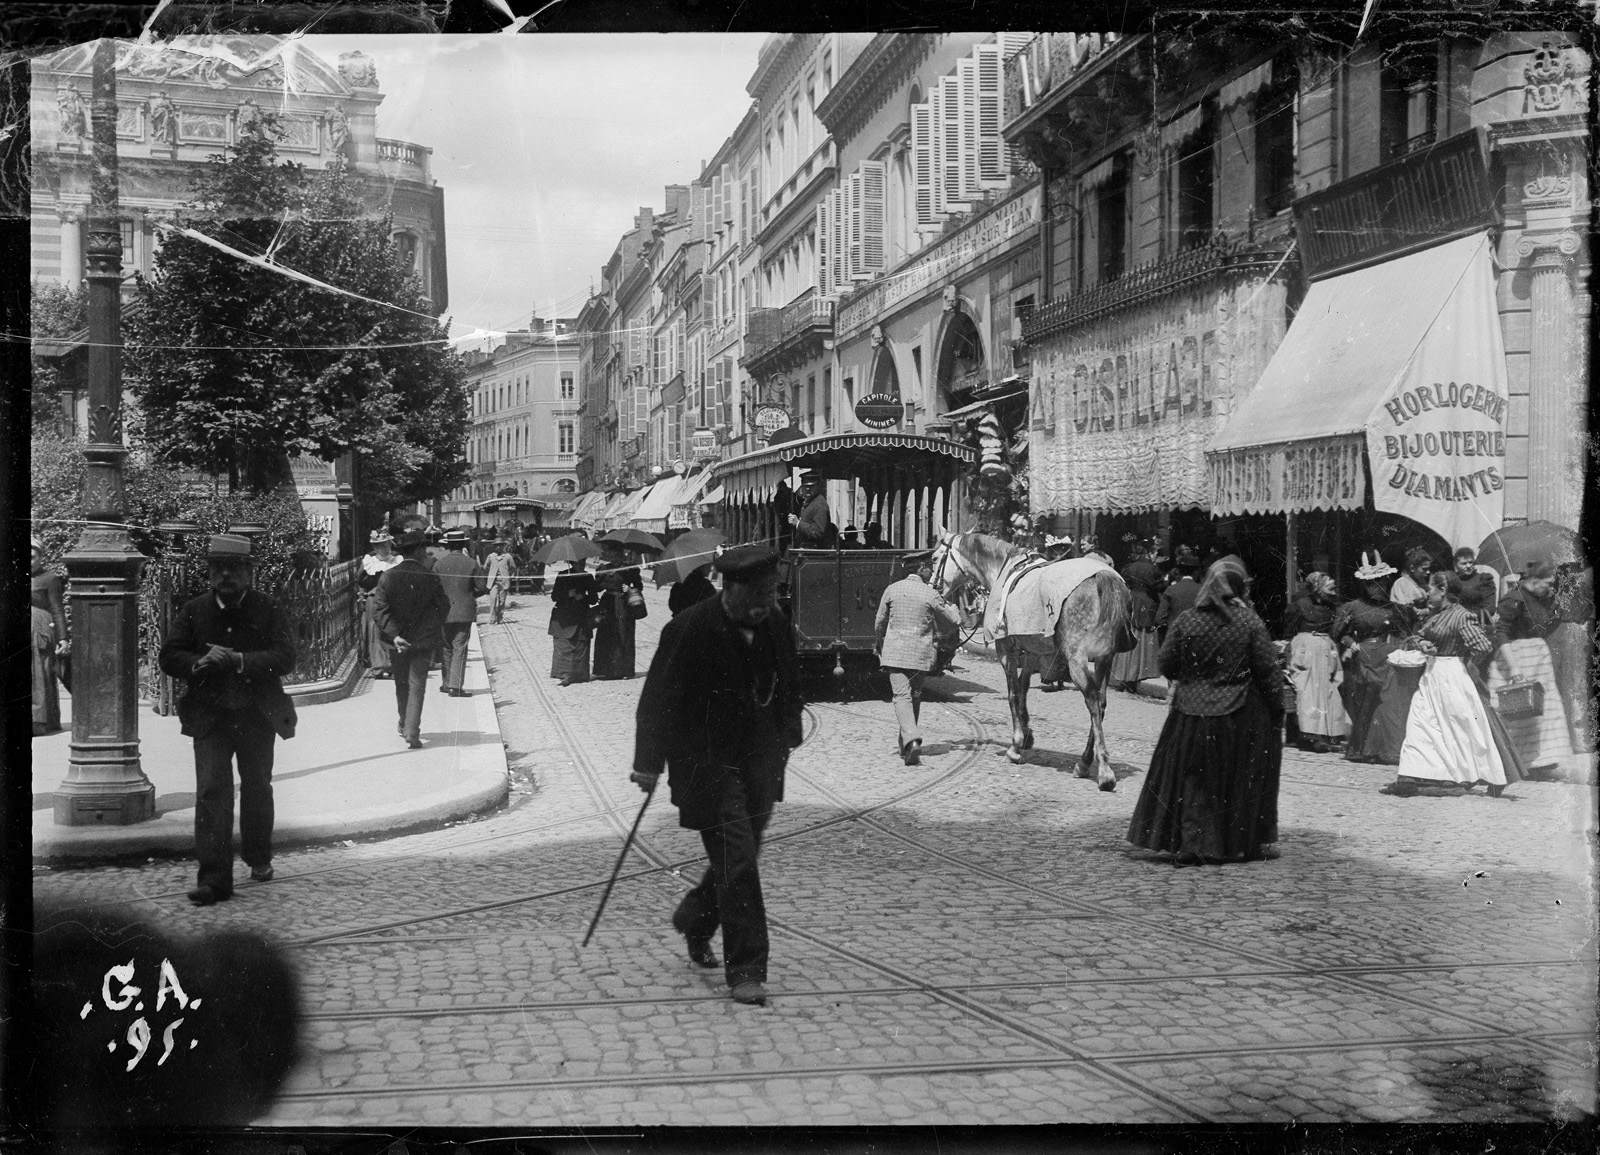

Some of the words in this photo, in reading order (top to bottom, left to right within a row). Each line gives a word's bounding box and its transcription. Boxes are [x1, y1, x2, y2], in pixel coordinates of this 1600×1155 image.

[995, 195, 1023, 223] MIDI
[981, 222, 1000, 246] SUR
[1003, 205, 1032, 234] PLAN
[861, 392, 898, 404] CAPITOLE
[1384, 382, 1505, 426] HORLOGERIE
[864, 417, 896, 427] MINIMES
[1384, 431, 1505, 459] BIJOUTERIE
[1389, 464, 1503, 501] DIAMANTS
